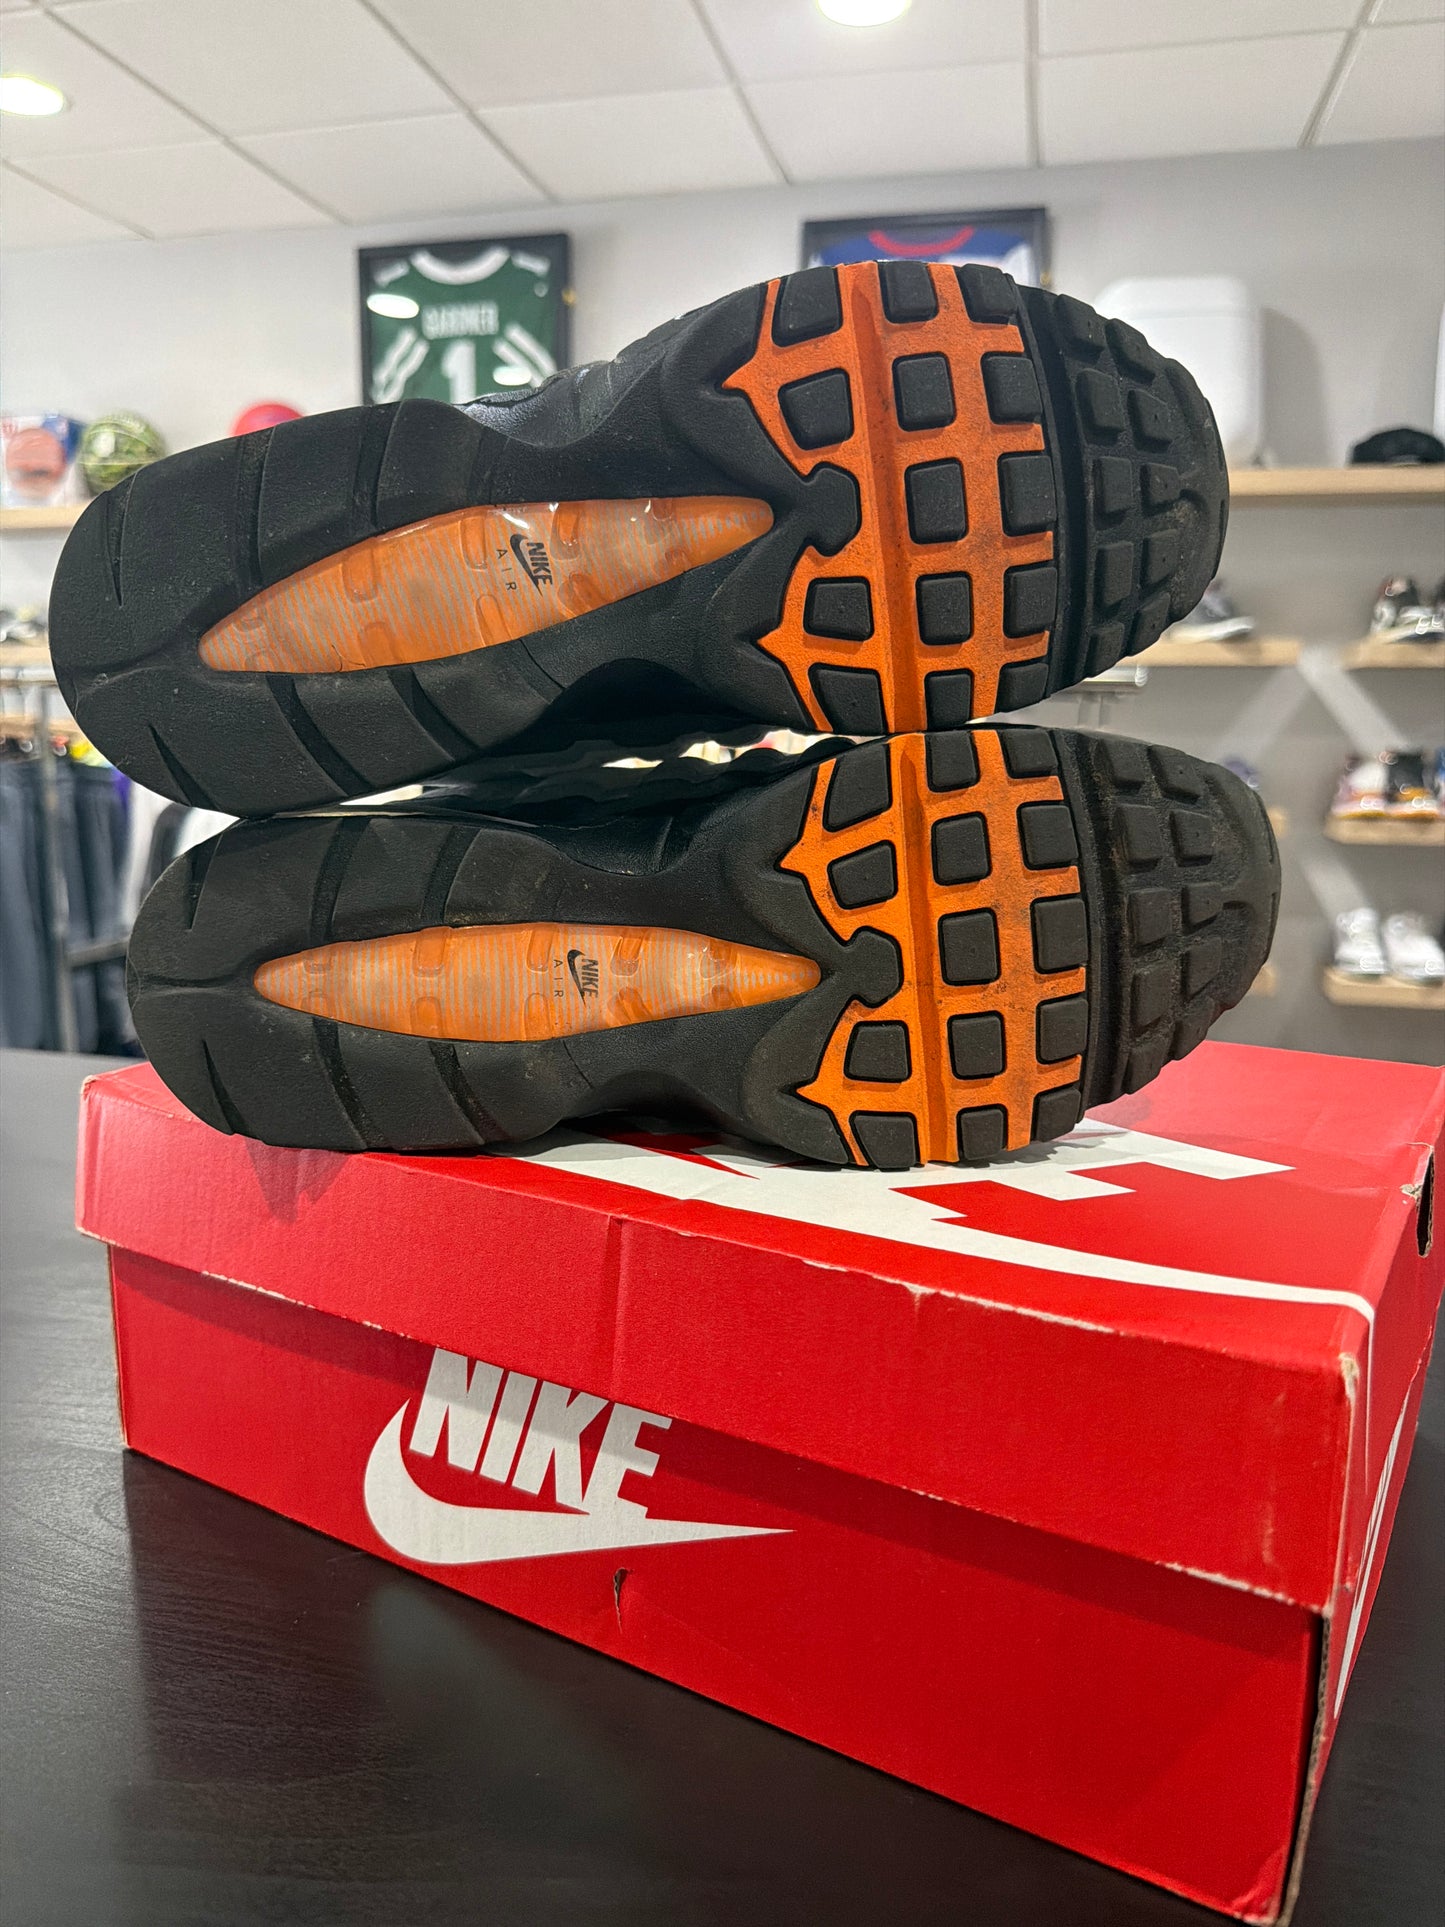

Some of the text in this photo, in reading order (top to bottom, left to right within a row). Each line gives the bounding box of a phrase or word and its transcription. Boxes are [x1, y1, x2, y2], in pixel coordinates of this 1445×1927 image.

[442, 339, 477, 404] 1
[496, 548, 517, 591] AIR
[526, 541, 553, 586] NIKE
[553, 958, 564, 998] AIR
[581, 958, 599, 999] NIKE
[409, 1347, 673, 1519] NIKE
